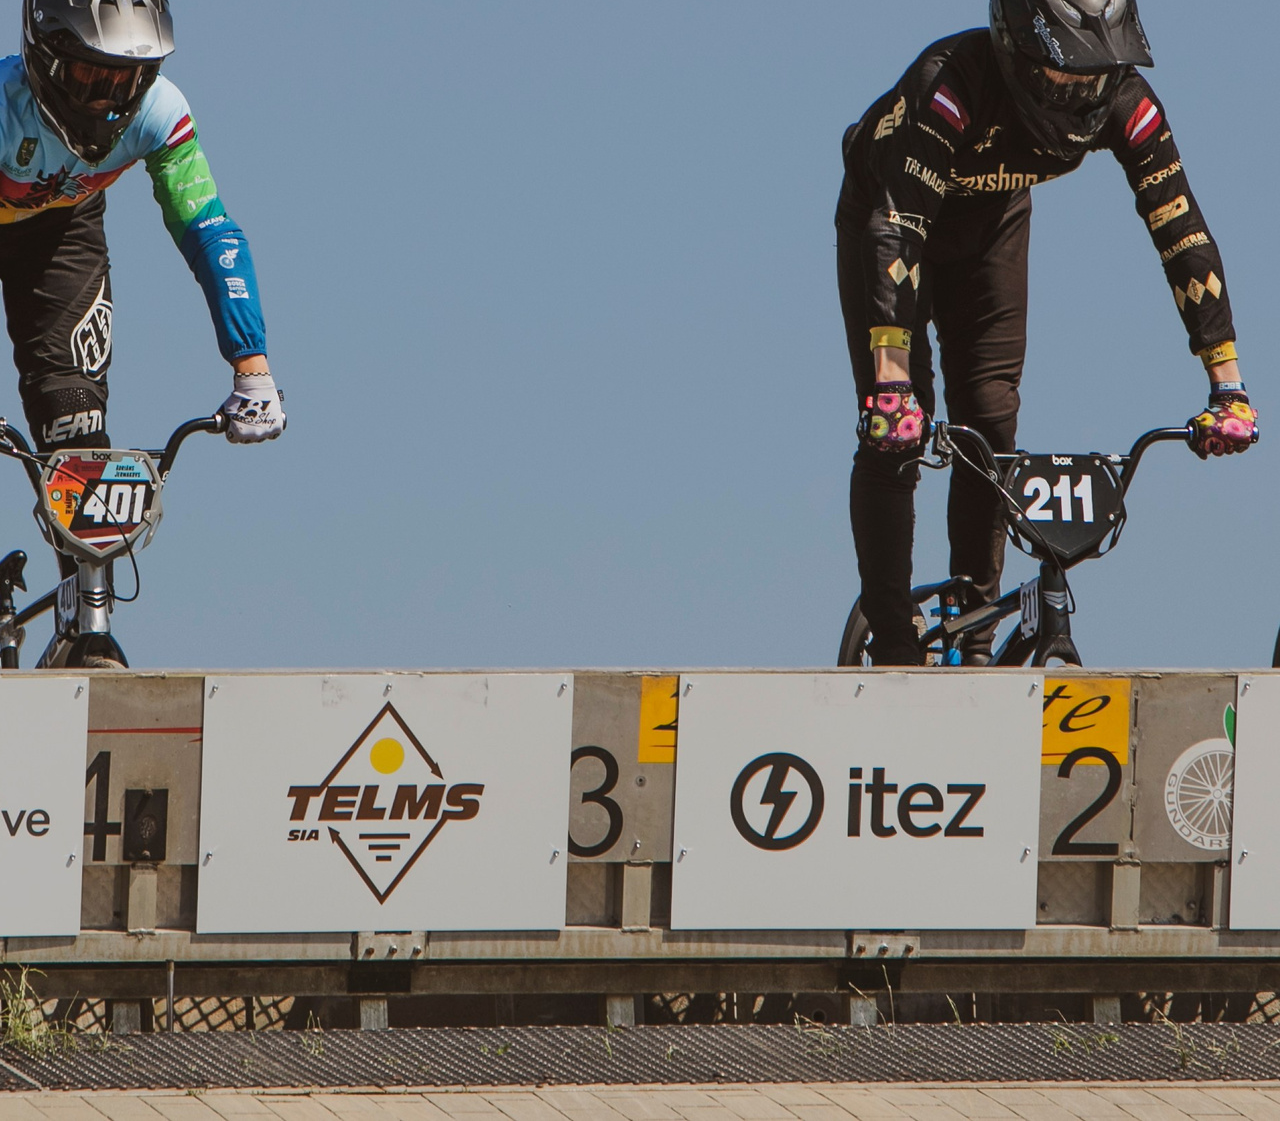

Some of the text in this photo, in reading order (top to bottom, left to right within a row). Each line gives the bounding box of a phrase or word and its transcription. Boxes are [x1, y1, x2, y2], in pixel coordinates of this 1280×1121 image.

[92, 451, 112, 461] box
[1052, 455, 1073, 466] box
[83, 484, 146, 523] 401
[1023, 475, 1094, 523] 211
[1022, 586, 1037, 626] 211
[287, 783, 485, 821] TELMS
[568, 746, 624, 858] 3
[847, 767, 986, 838] itez
[1052, 746, 1122, 856] 2
[287, 829, 320, 841] SIA
